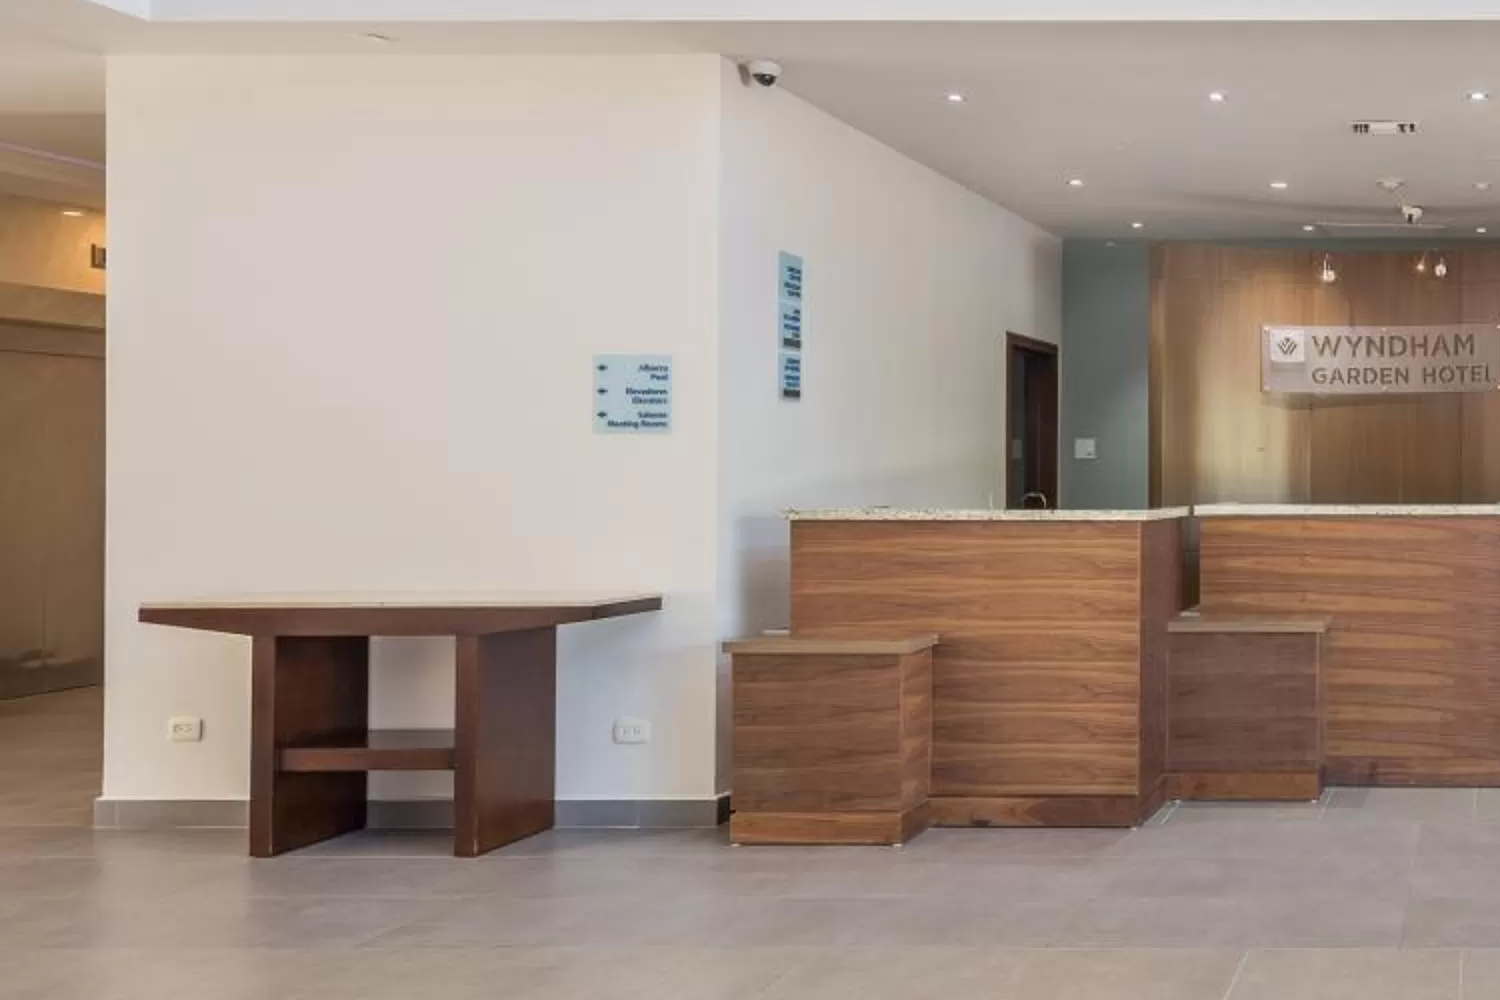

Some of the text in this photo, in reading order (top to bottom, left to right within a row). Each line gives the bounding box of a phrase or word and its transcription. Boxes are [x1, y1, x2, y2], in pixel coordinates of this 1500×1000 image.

[1312, 333, 1475, 357] WYNDHAM
[1312, 364, 1496, 385] GARDEN HOTEL
